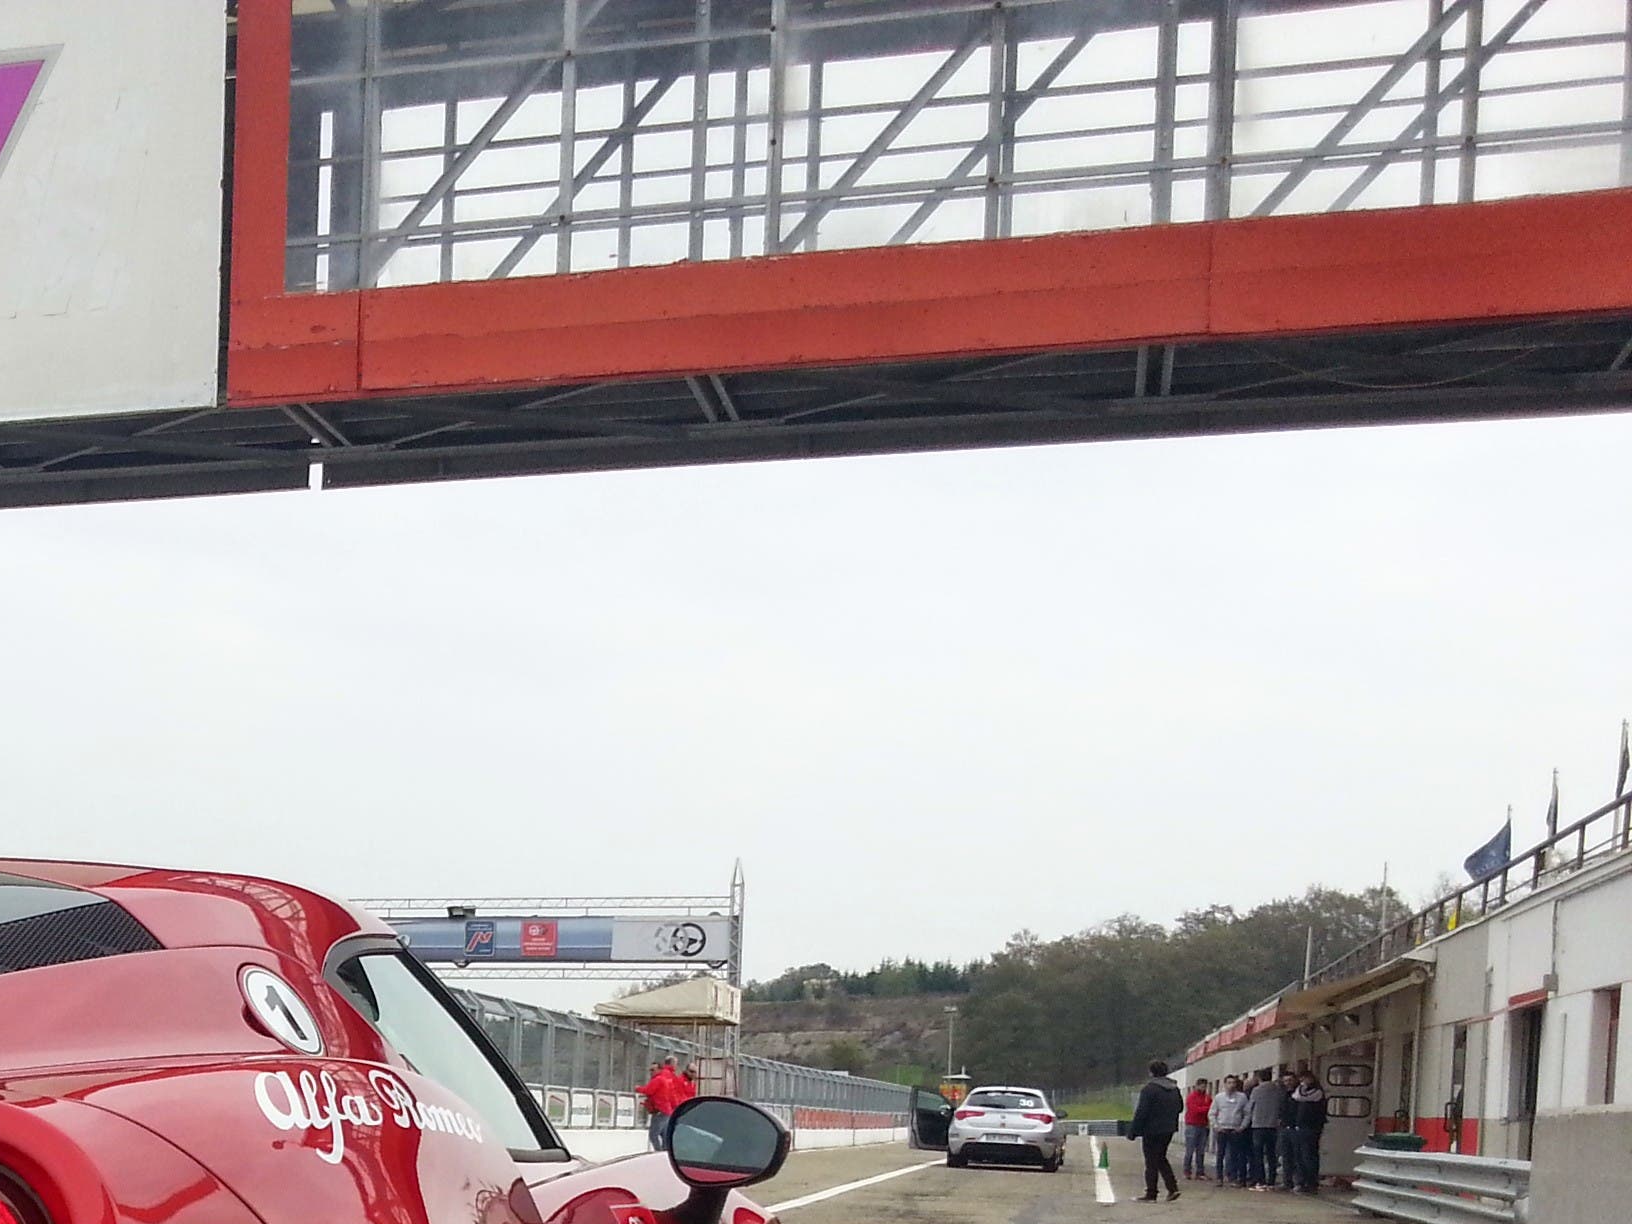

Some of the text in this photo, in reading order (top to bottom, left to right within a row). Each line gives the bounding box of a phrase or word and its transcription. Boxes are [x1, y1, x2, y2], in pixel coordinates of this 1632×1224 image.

[264, 985, 308, 1041] 1
[254, 1069, 483, 1164] Alfa Romeo
